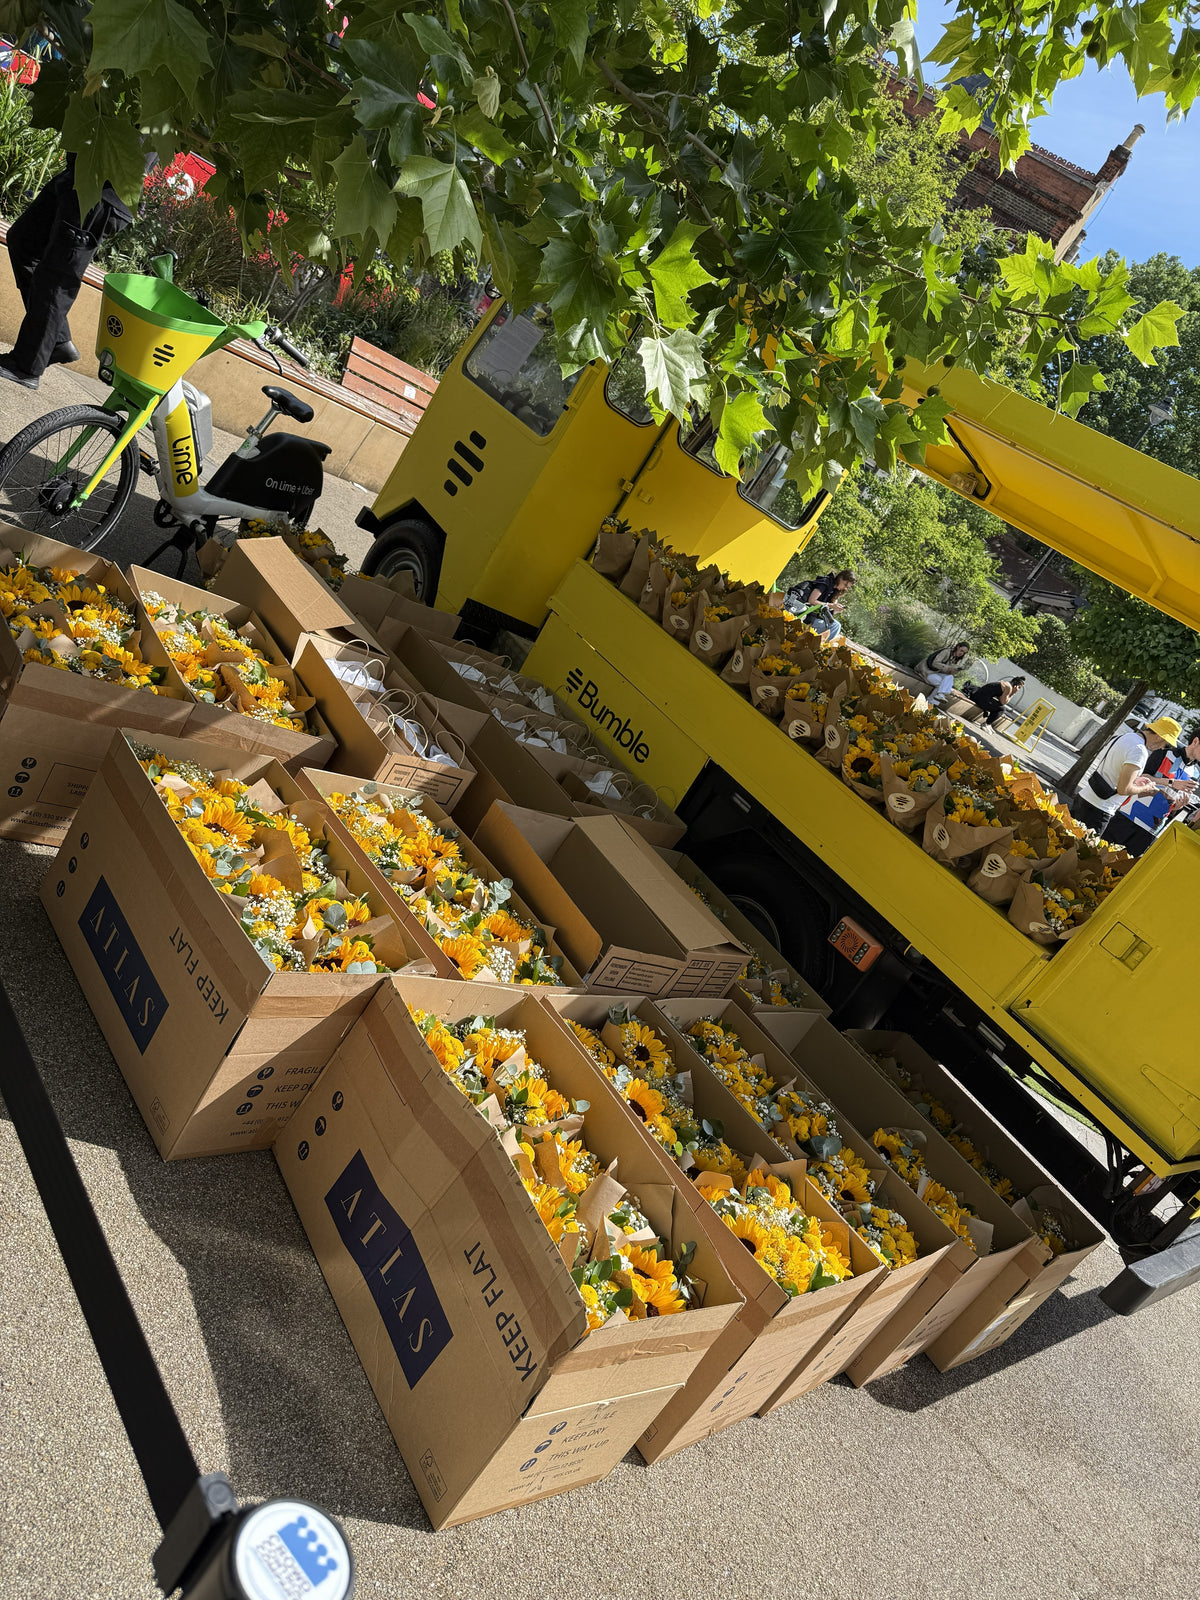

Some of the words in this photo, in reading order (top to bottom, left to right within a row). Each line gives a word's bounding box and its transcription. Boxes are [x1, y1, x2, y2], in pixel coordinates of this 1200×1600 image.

[172, 435, 194, 486] Lime
[265, 477, 279, 489] On
[279, 480, 297, 493] Lime
[301, 484, 315, 495] Uber
[577, 679, 650, 764] Bumble
[10, 816, 68, 831] www.atlasflowers.
[90, 906, 155, 1027] ATLAS
[169, 926, 200, 976] FLAT
[196, 974, 230, 1025] KEEP
[265, 1102, 288, 1111] THIS
[274, 1084, 300, 1093] KEEP
[340, 1188, 434, 1353] ATLAS
[463, 1241, 504, 1308] FLAT
[495, 1311, 538, 1382] KEEP
[549, 1449, 572, 1461] THIS
[571, 1443, 596, 1455] WAY
[594, 1439, 610, 1449] UP
[561, 1430, 588, 1444] KEEP
[586, 1426, 609, 1438] DRY
